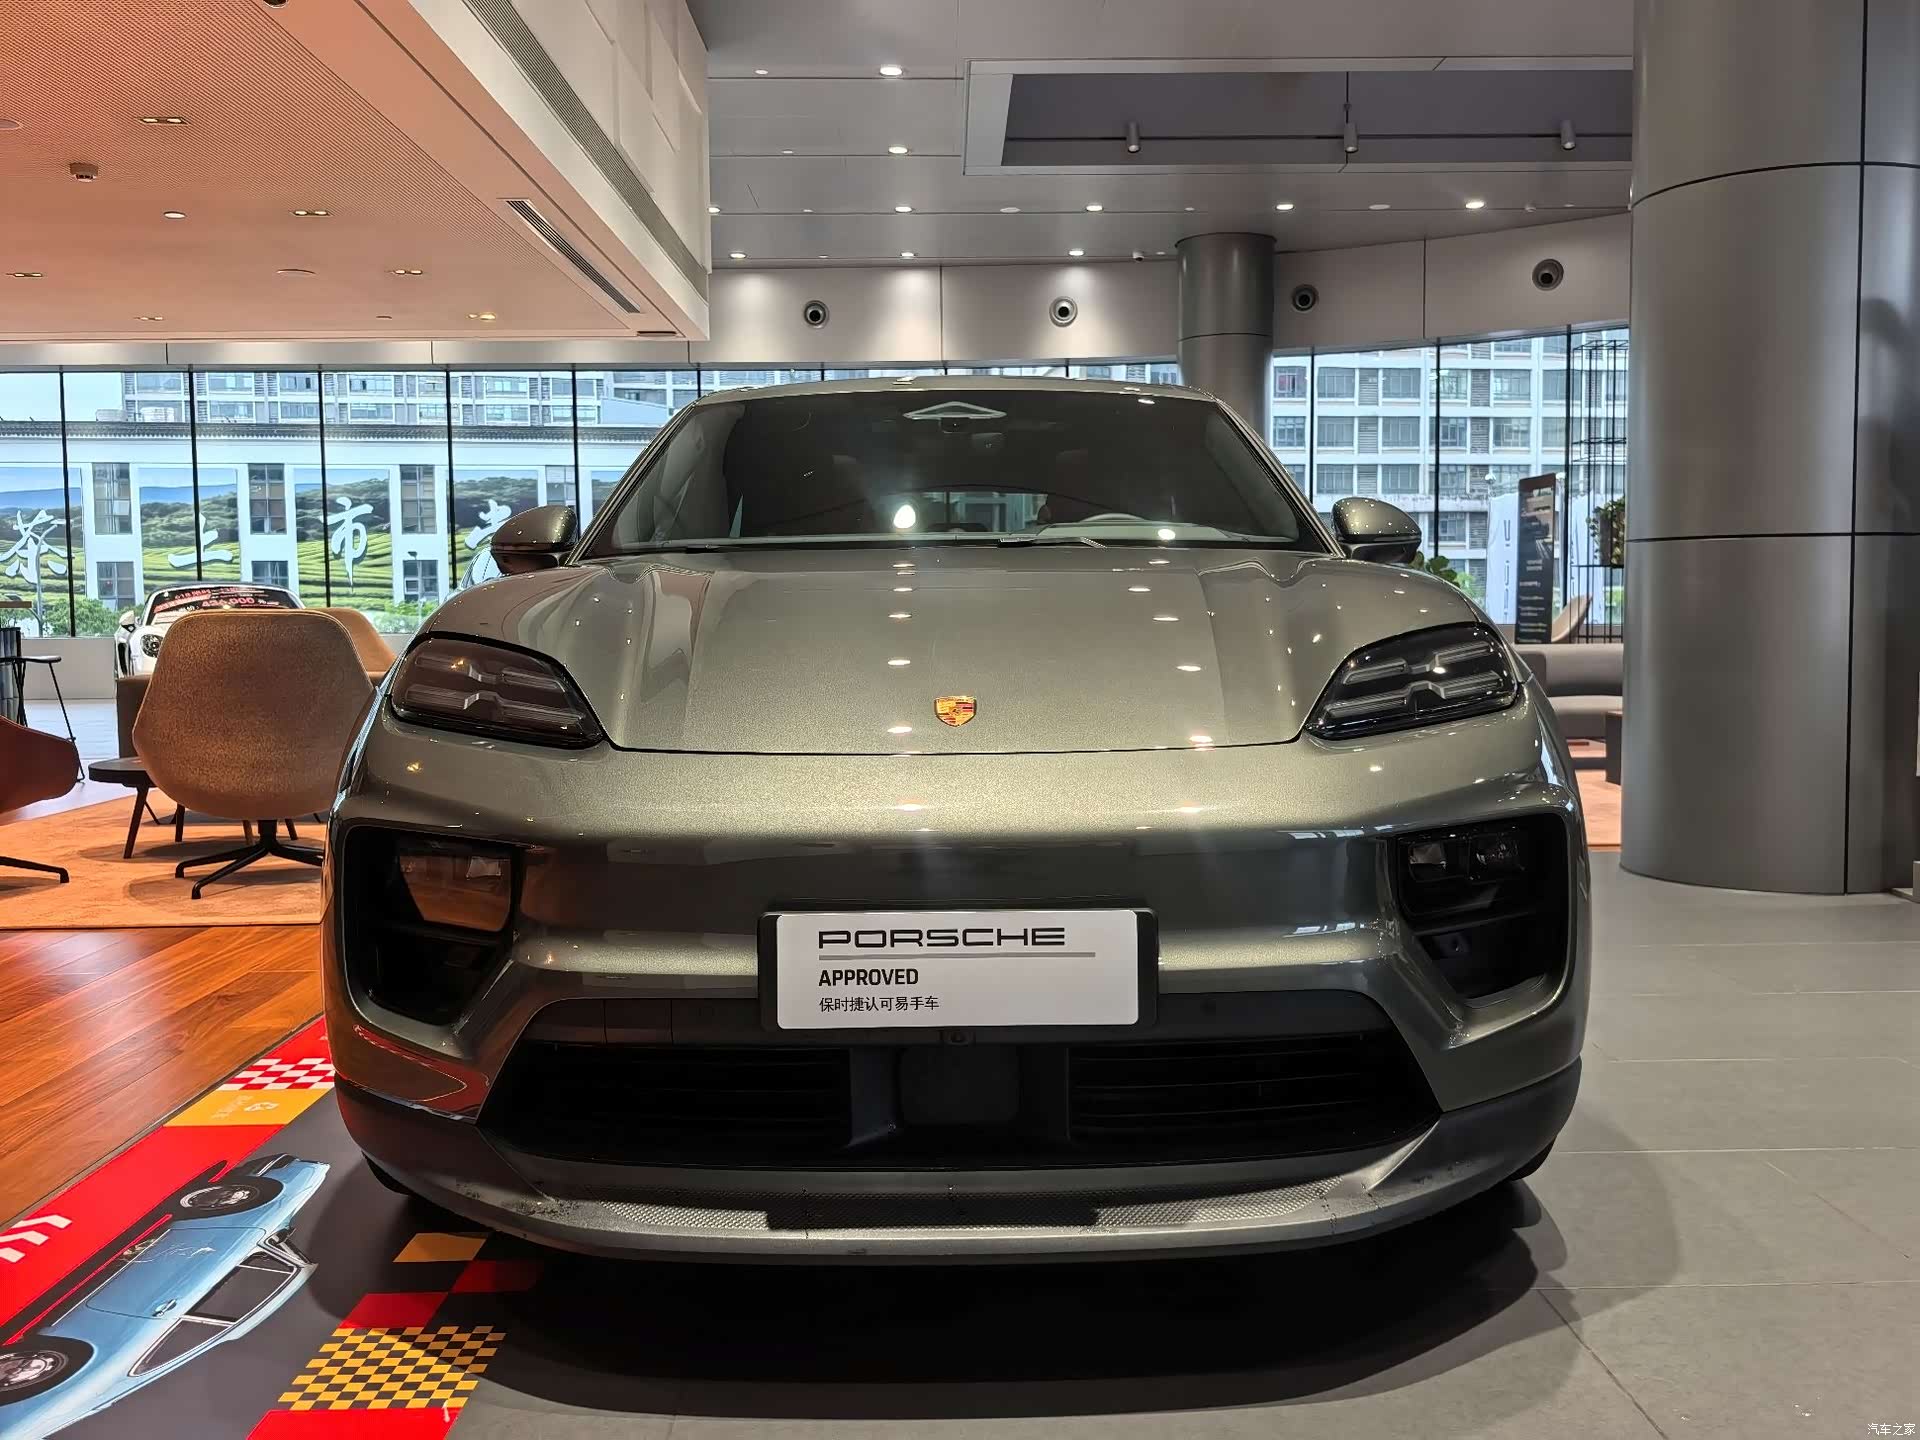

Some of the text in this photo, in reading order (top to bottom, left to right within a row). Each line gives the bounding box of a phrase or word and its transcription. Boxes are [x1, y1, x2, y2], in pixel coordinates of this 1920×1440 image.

[818, 927, 1066, 949] PORSCHE
[818, 967, 919, 987] APPROVED
[818, 995, 940, 1013] 保时捷认可易手车
